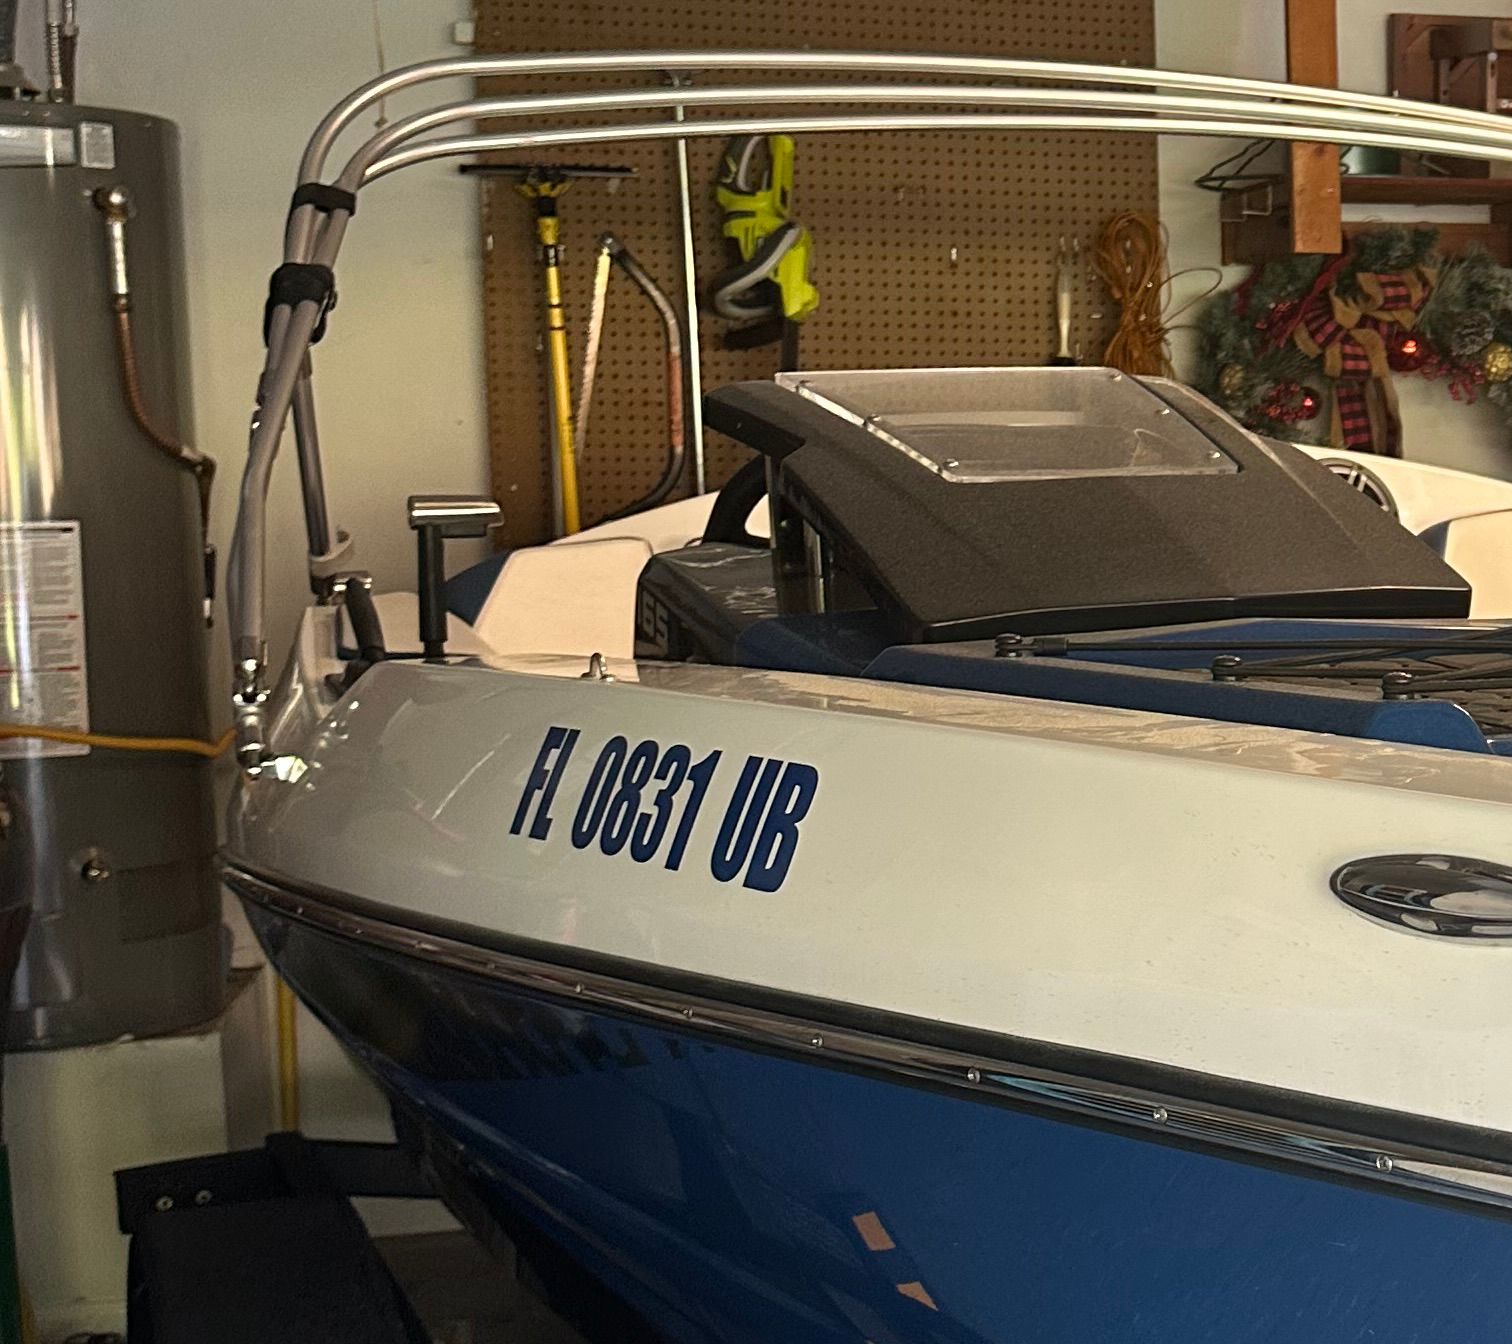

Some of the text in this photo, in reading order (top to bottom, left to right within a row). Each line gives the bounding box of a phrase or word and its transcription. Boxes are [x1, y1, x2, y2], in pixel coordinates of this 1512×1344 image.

[509, 725, 819, 893] FL 0831 UB
